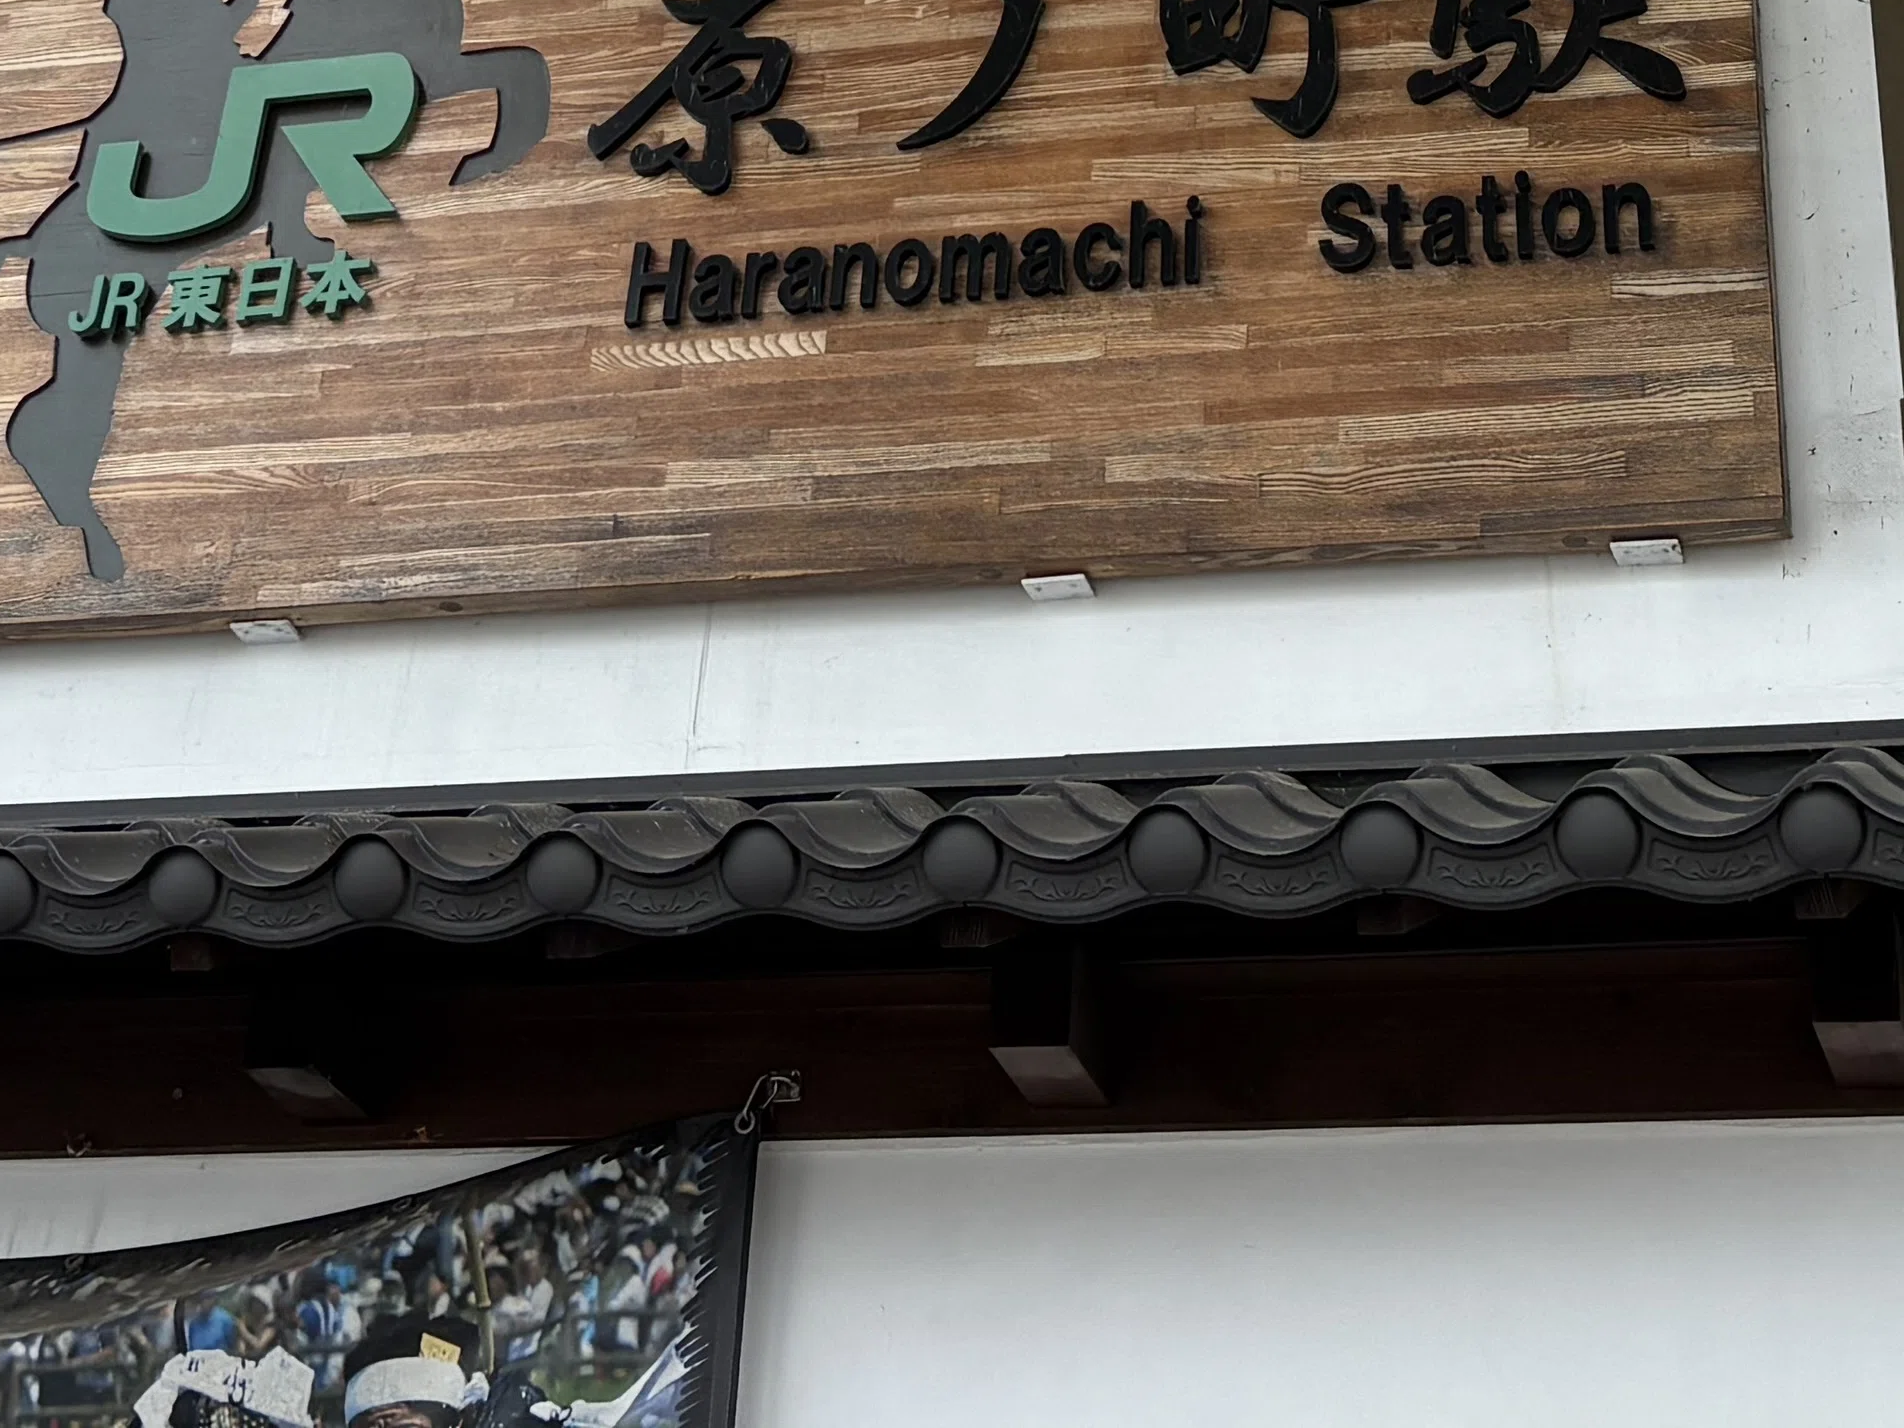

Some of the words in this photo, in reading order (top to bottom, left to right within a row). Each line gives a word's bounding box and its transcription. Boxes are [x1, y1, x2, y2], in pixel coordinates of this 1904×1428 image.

[86, 51, 419, 242] JR
[624, 194, 1203, 329] Haranomachi
[1317, 169, 1656, 274] Station
